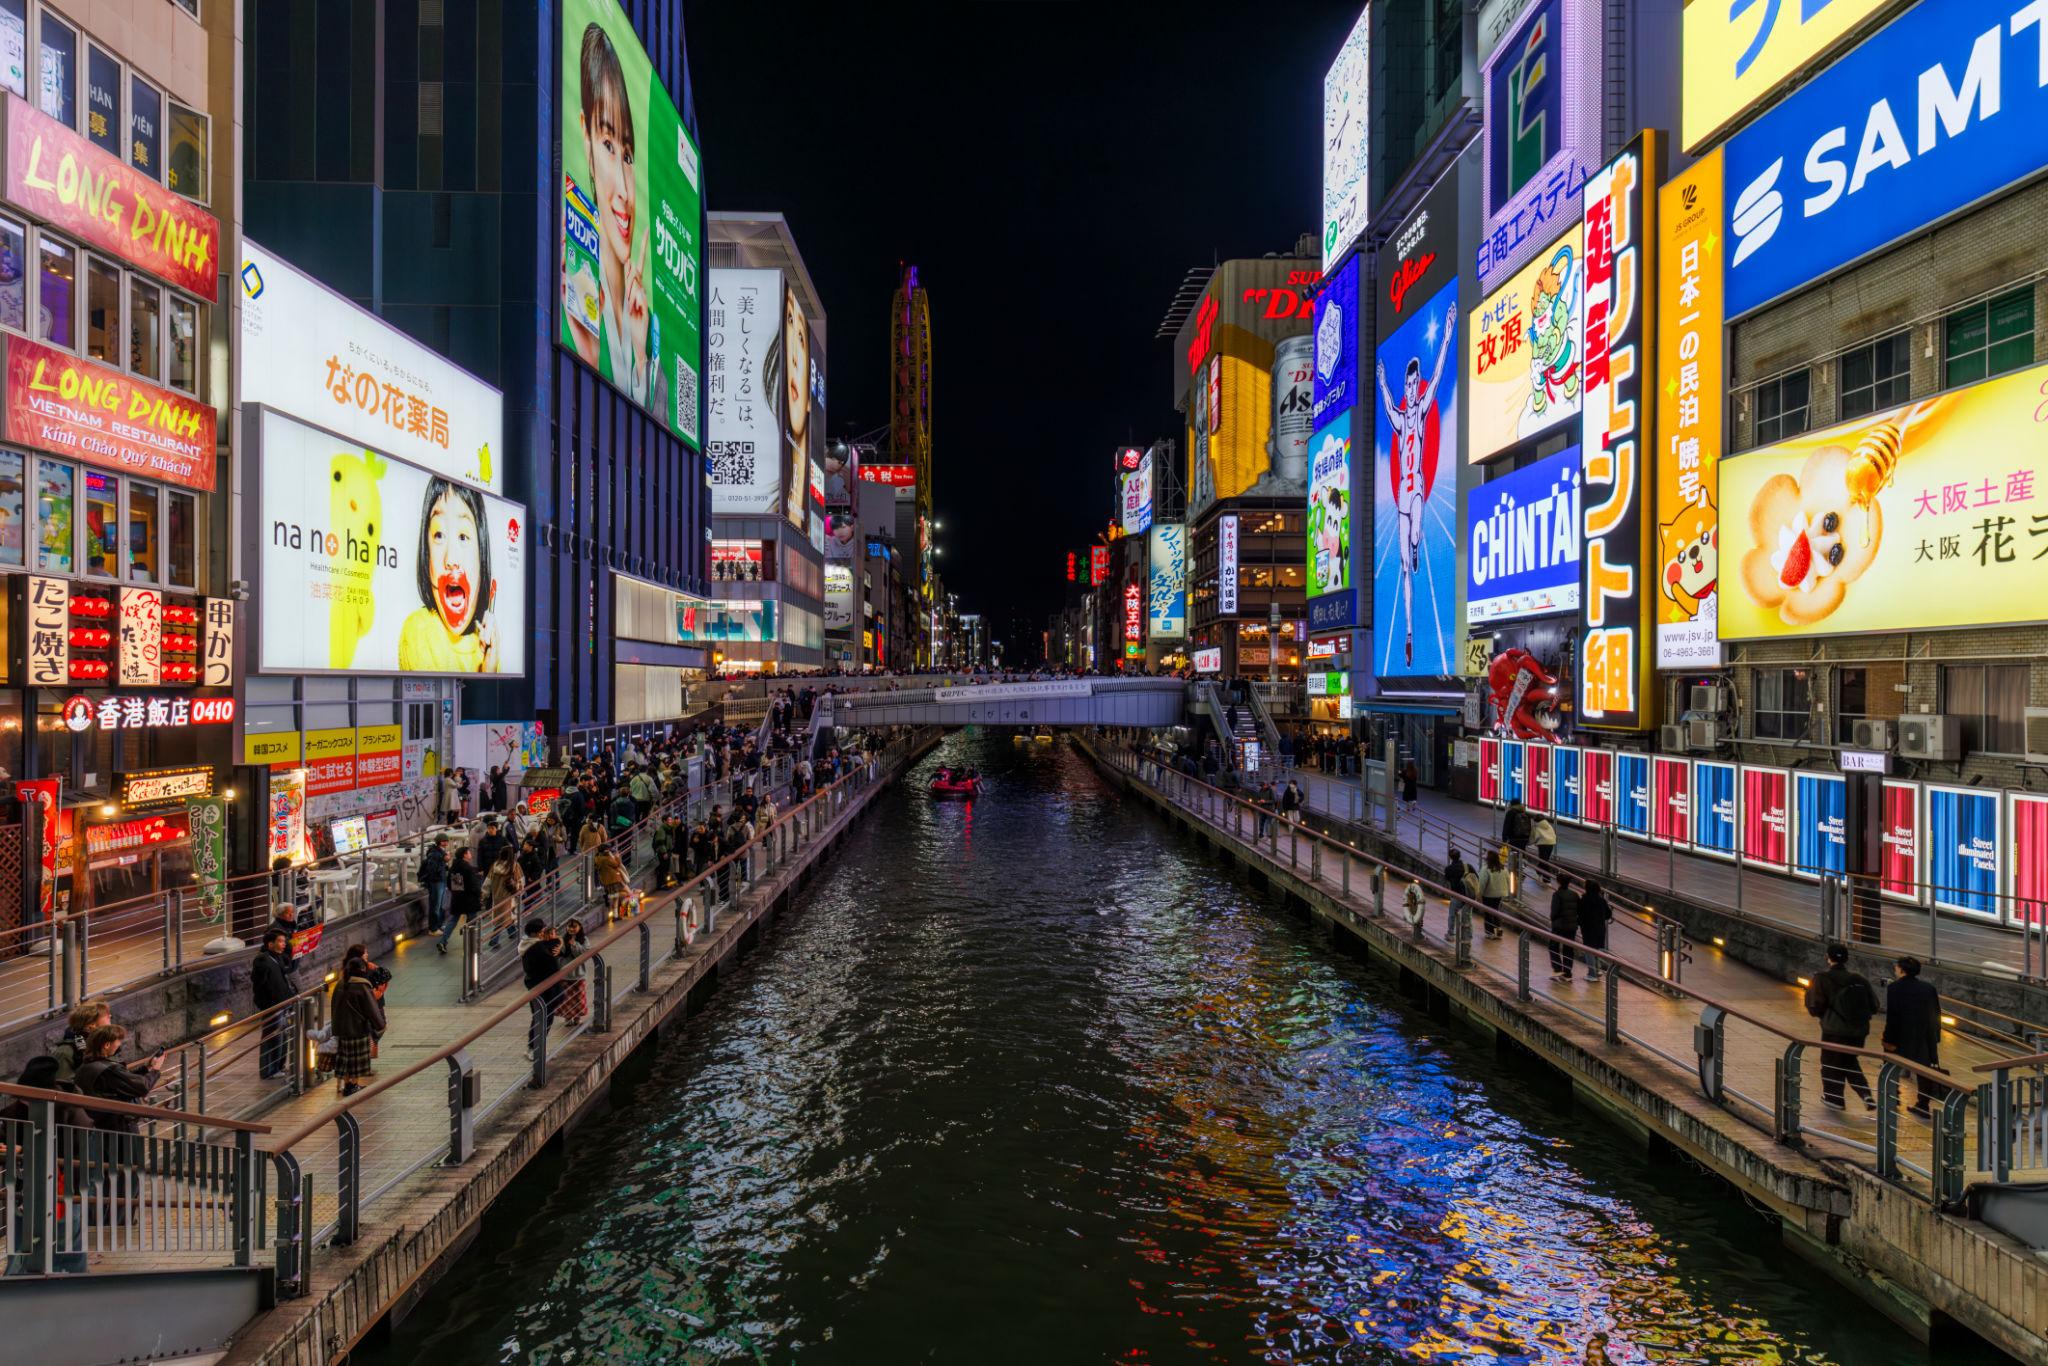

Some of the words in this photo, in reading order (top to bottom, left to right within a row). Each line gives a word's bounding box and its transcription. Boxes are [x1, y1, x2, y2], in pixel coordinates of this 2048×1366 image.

[23, 135, 124, 233] LONG
[131, 192, 210, 272] DINH
[1476, 158, 1590, 282] 日商エステム
[1287, 271, 1324, 285] SUP
[1390, 252, 1436, 313] Glico
[1481, 292, 1519, 332] かぜに
[1679, 239, 1701, 427] 日本一の民泊
[709, 286, 727, 425] 人間の権利だ。
[735, 286, 758, 431] 「美しくなる」は、
[1476, 311, 1523, 375] 改源
[29, 358, 119, 414] LONG
[128, 389, 202, 439] DINH
[29, 395, 102, 428] VIETNAM
[111, 420, 201, 458] RESTAURANT
[325, 354, 450, 449] なの花薬局
[1314, 446, 1343, 483] 牧場の朝
[1913, 469, 2036, 519] 大阪土産
[1472, 466, 1580, 587] CHINTAI
[1914, 533, 1961, 563] 大阪
[1126, 584, 1140, 640] 大阪王将
[1225, 565, 1235, 610] かに道楽
[32, 579, 65, 683] たこ焼き
[207, 600, 232, 685] 串かつ
[1663, 647, 1715, 658] 06-4963-3661
[1664, 630, 1714, 644] www.jsv.jp
[97, 698, 190, 729] 香港飯店
[193, 701, 233, 721] 0410
[362, 733, 396, 745] ブランドコスメ
[253, 741, 288, 755] 韓国コスメ
[305, 736, 354, 751] オーガニックコスメ
[1842, 754, 1865, 767] BAR
